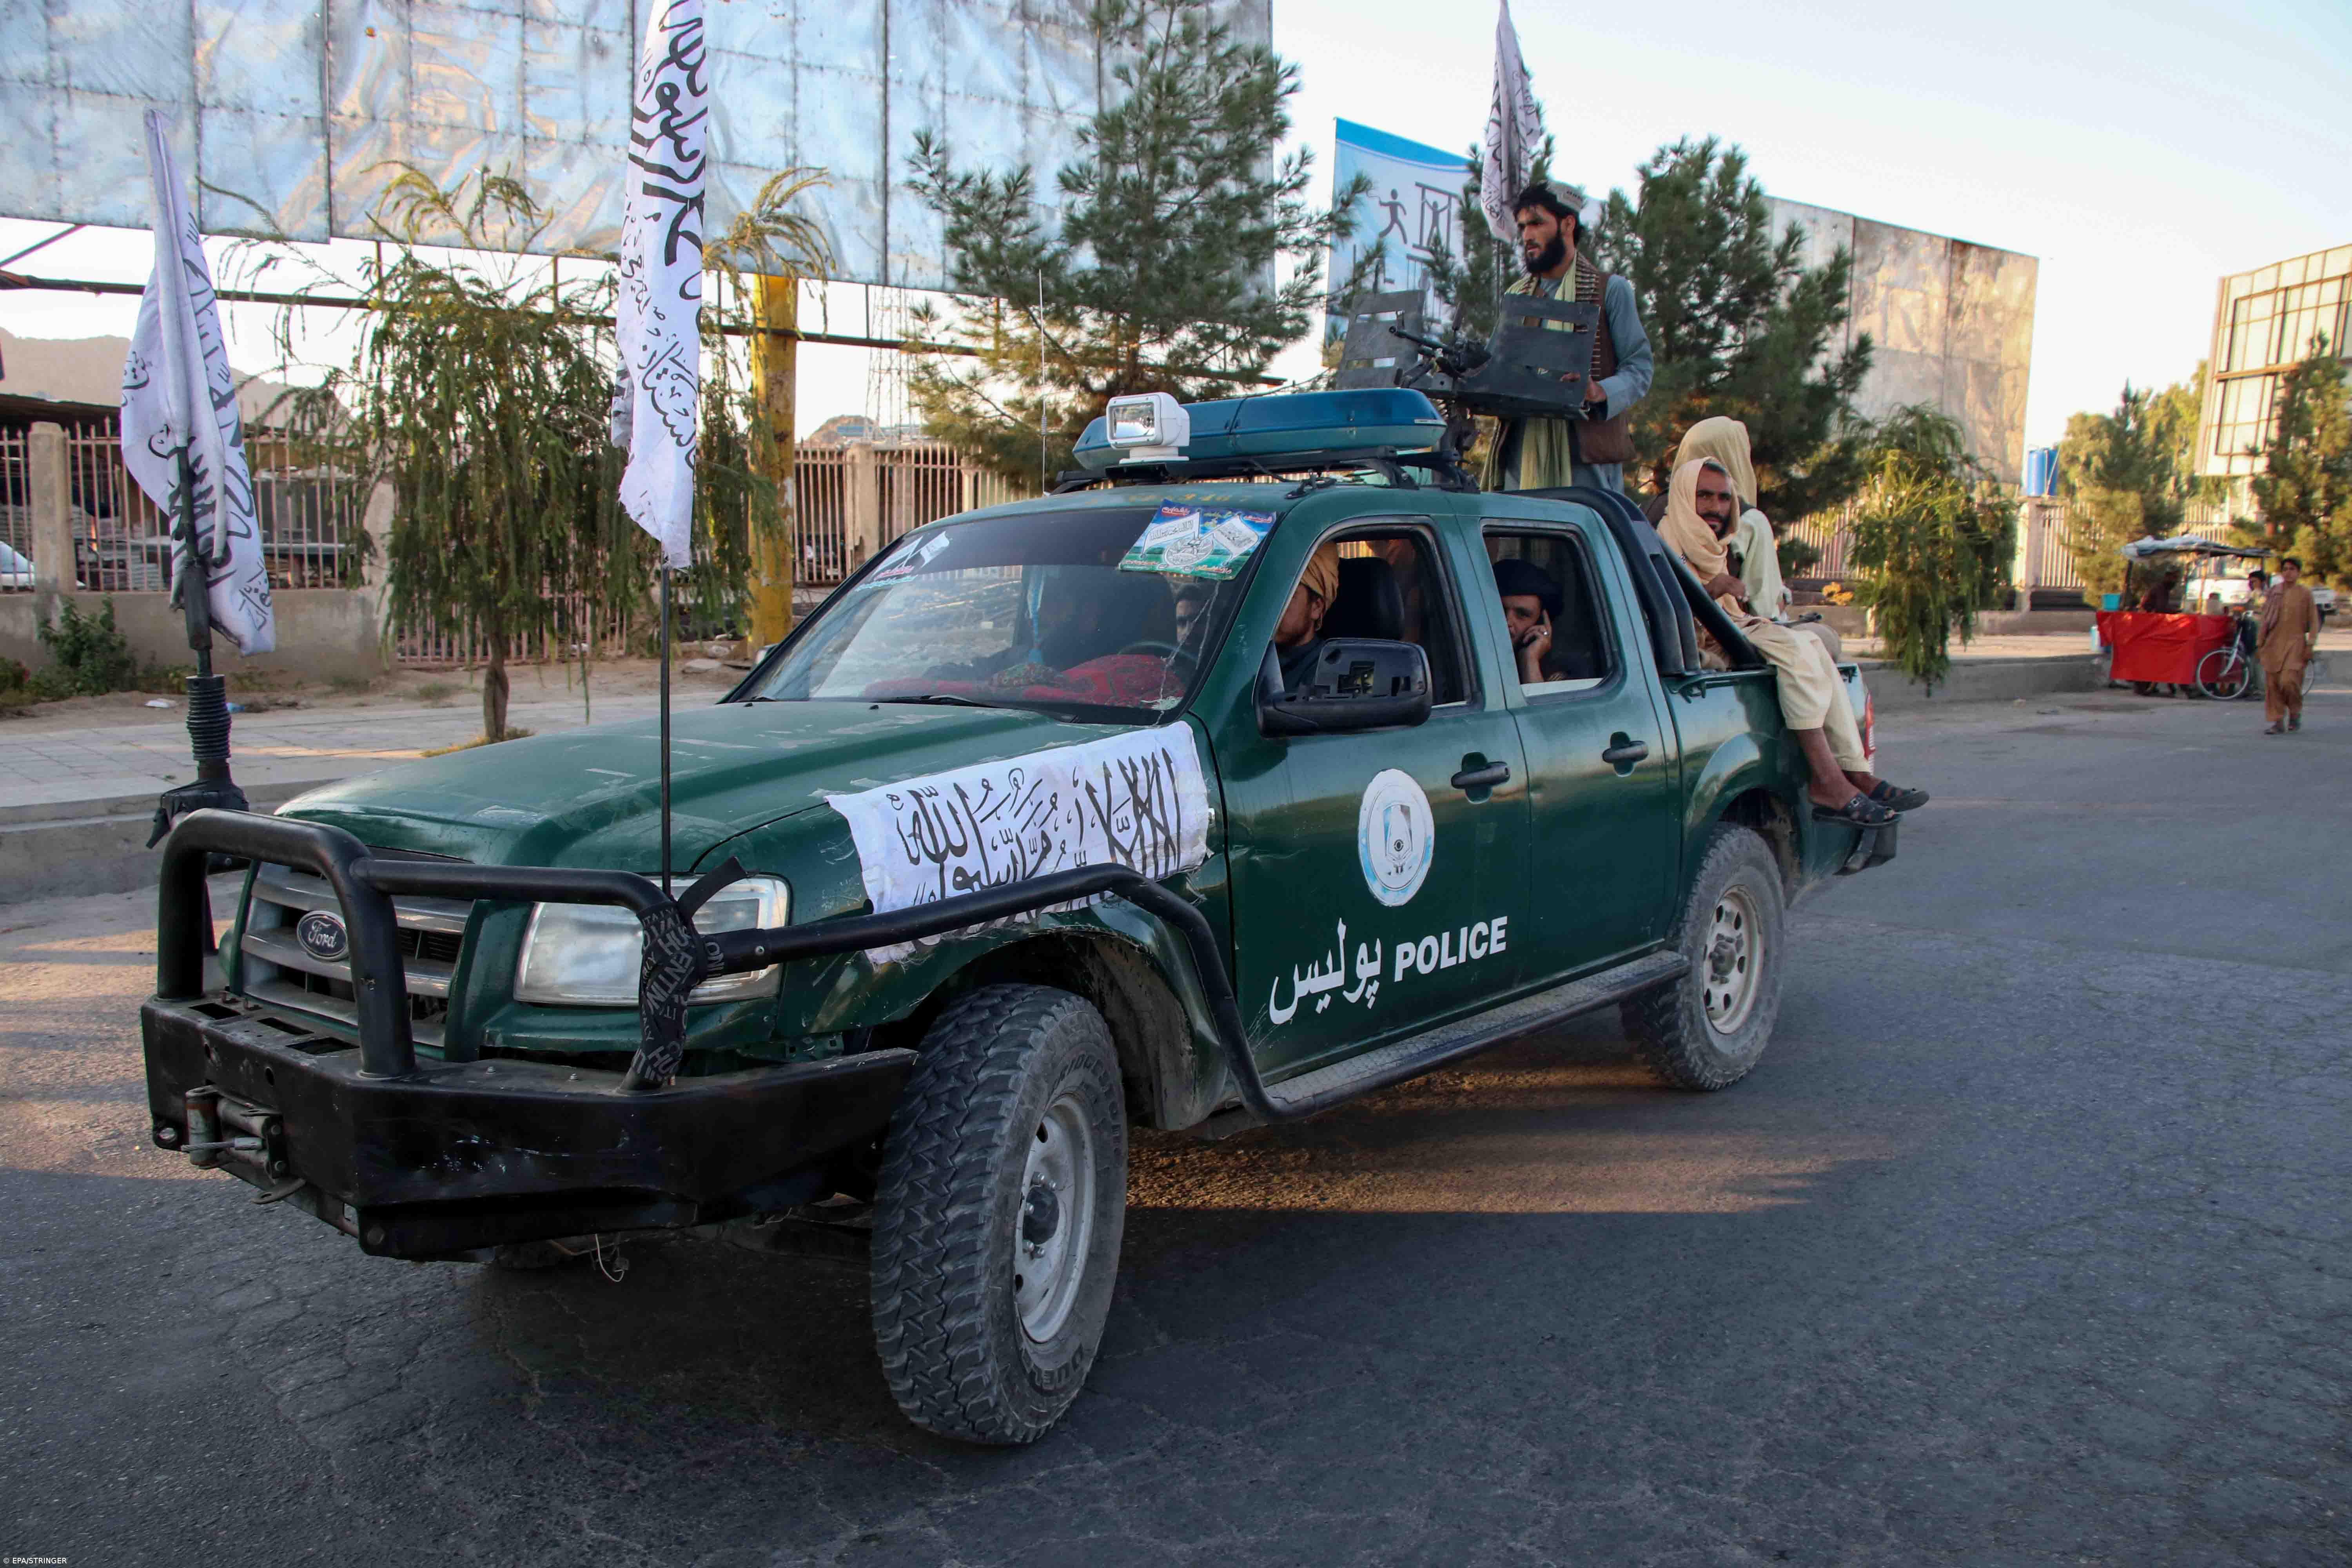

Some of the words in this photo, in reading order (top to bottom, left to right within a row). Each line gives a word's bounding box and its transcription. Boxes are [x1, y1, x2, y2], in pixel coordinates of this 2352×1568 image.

[308, 920, 338, 948] Ford
[1394, 916, 1508, 982] POLICE
[1269, 917, 1382, 1025] پولیس
